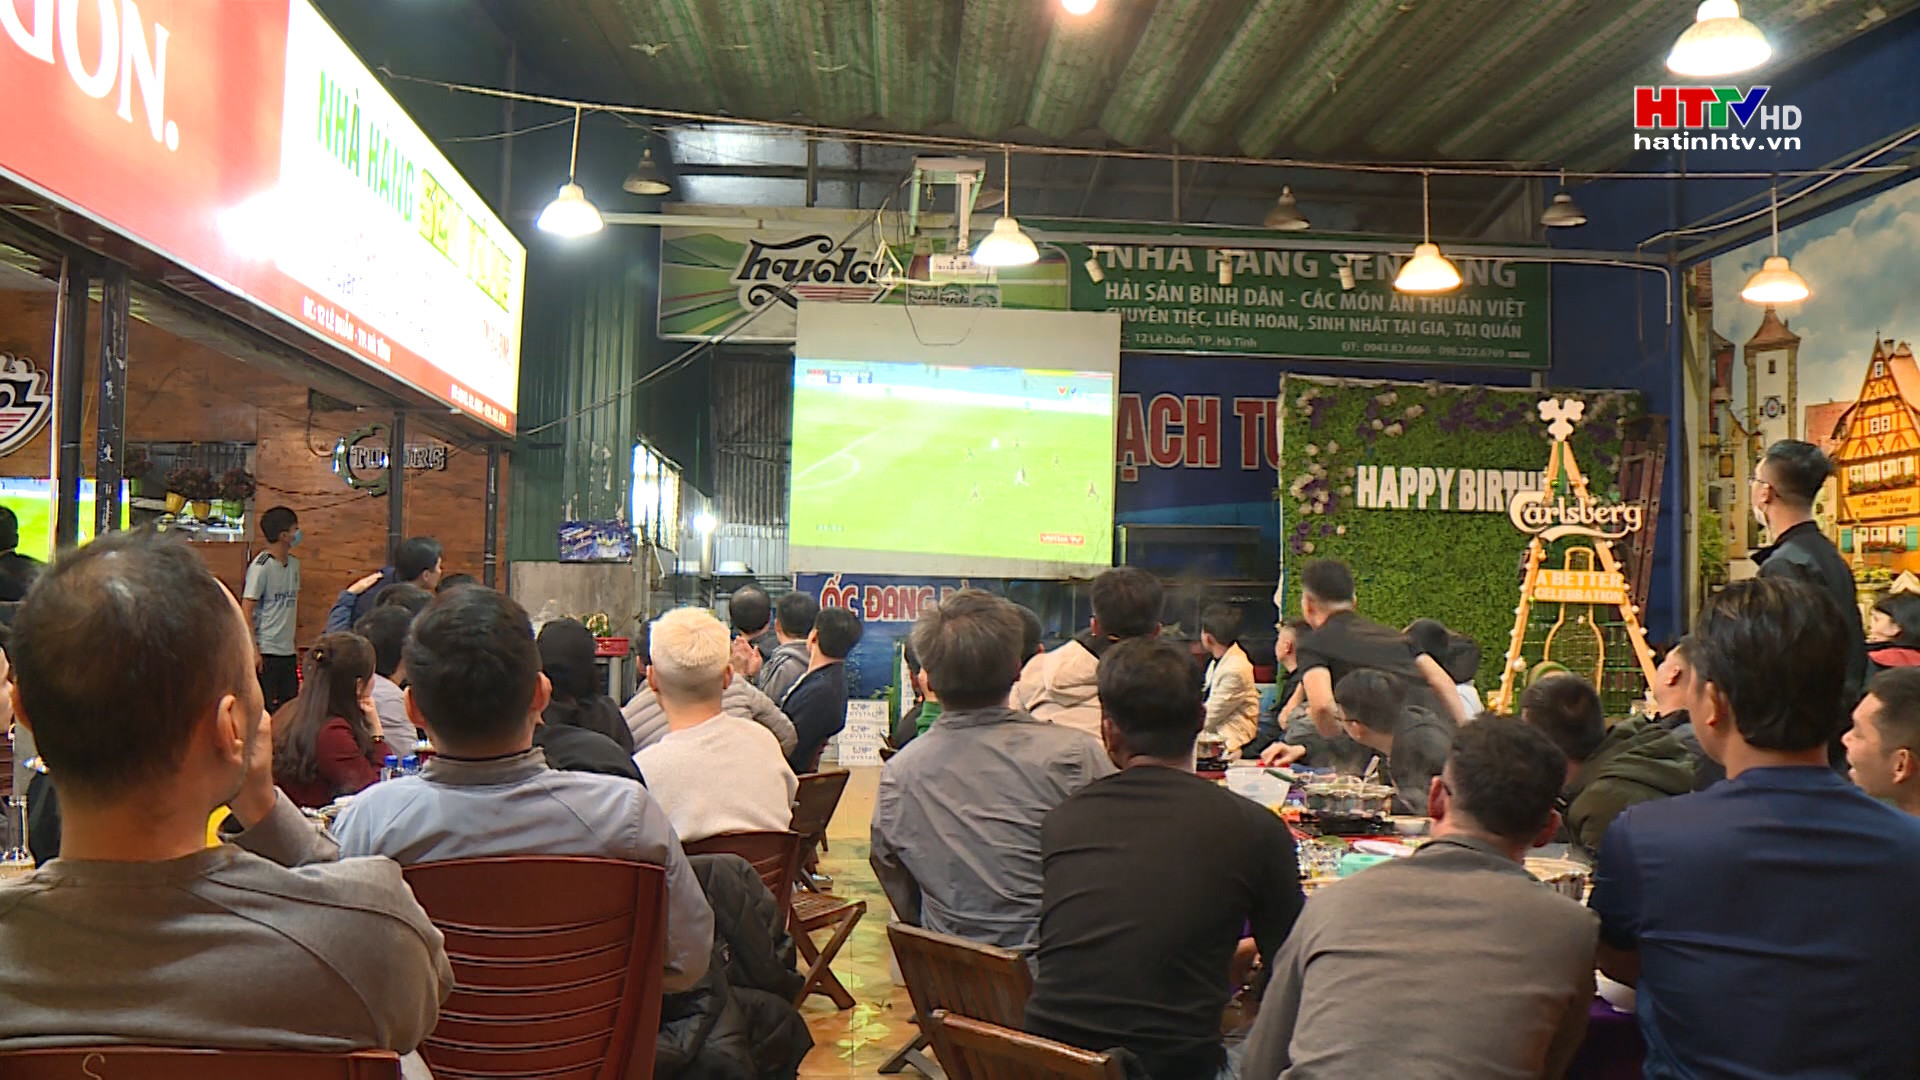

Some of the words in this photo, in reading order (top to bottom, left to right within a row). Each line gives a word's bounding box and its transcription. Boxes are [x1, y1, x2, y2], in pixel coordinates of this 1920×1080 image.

[317, 70, 360, 178] NHÀ
[367, 121, 414, 224] HÀNG
[1105, 278, 1140, 301] HẢI
[1145, 280, 1184, 302] SẢN
[1190, 284, 1239, 305] BÌNH
[1244, 286, 1284, 308] DÂN
[1301, 289, 1336, 310] CÁC
[1340, 289, 1384, 311] MÓN
[1106, 306, 1169, 324] HUYÊN
[1172, 308, 1211, 328] TIỆC,
[1216, 310, 1250, 328] LIÊN
[1255, 314, 1304, 332] HOAN,
[1307, 316, 1345, 332] SINH
[1393, 318, 1416, 338] TẠI
[1420, 321, 1450, 339] GIA,
[1454, 322, 1476, 340] TẠI
[1480, 318, 1522, 339] QUÁN
[1135, 334, 1147, 344] 12
[1357, 465, 1456, 510] HAPPY
[1510, 490, 1643, 533] Carlsberg
[1535, 571, 1548, 586] A
[1551, 572, 1622, 588] BETTER
[1535, 587, 1623, 602] CELEBRATION
